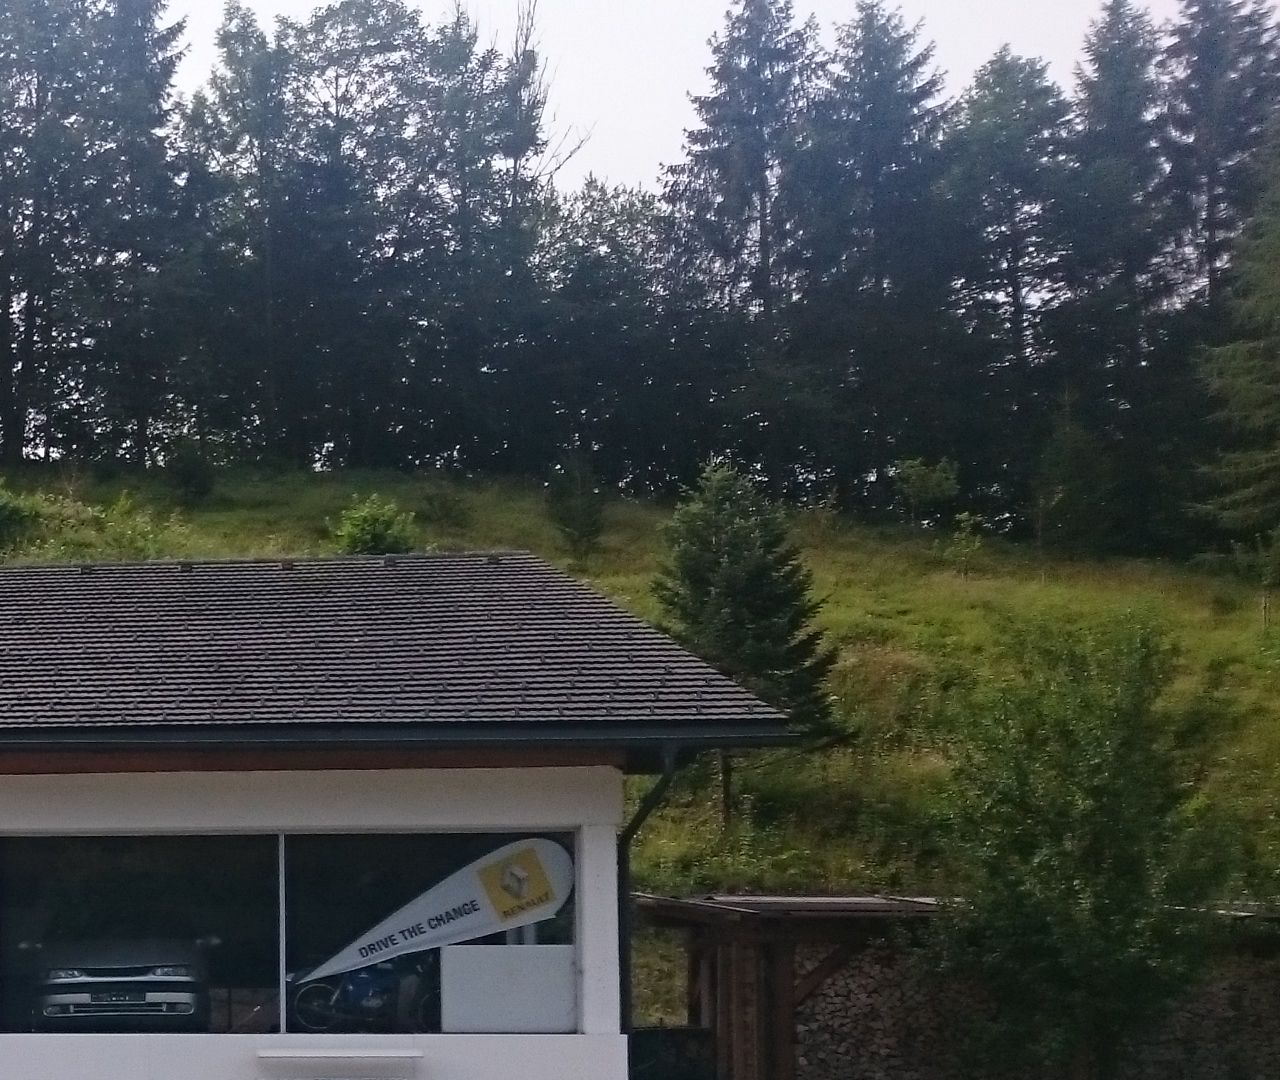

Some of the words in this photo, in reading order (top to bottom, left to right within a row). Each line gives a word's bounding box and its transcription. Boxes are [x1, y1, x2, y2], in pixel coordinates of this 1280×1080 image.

[503, 892, 551, 919] RENAULT
[358, 934, 400, 958] DRIVE
[399, 922, 427, 941] THE
[427, 900, 481, 930] CHANGE
